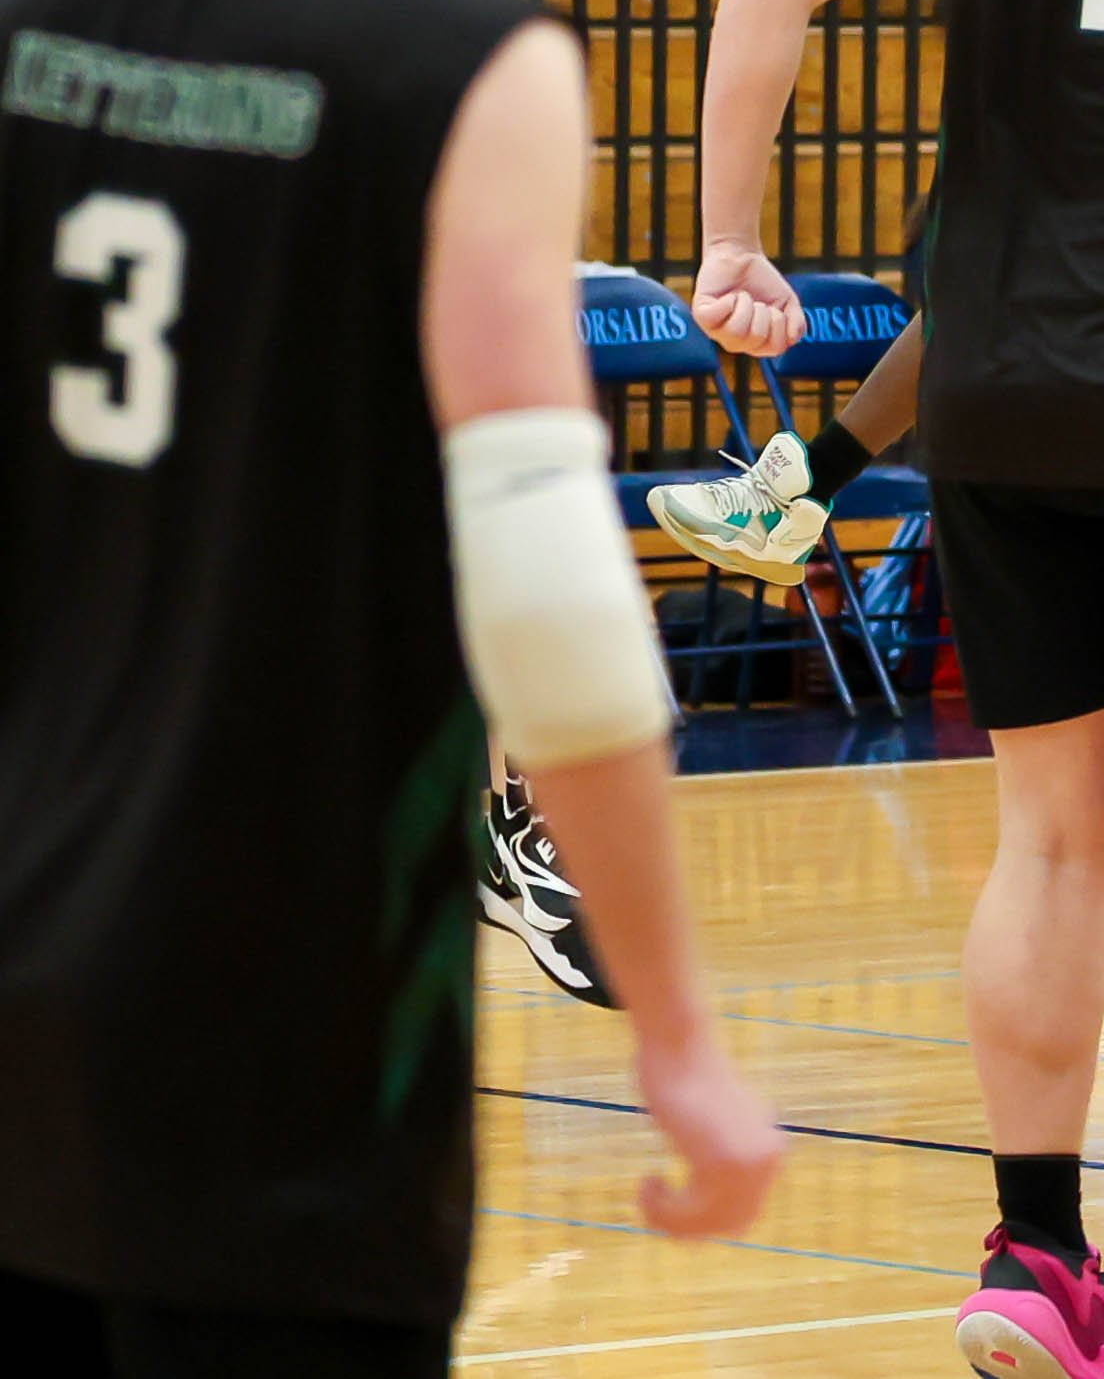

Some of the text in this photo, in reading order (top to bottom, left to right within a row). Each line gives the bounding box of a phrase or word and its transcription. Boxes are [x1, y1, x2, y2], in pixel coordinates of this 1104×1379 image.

[50, 192, 184, 468] 3
[575, 304, 688, 346] ORSAIRS
[801, 303, 909, 344] ORSAIRS
